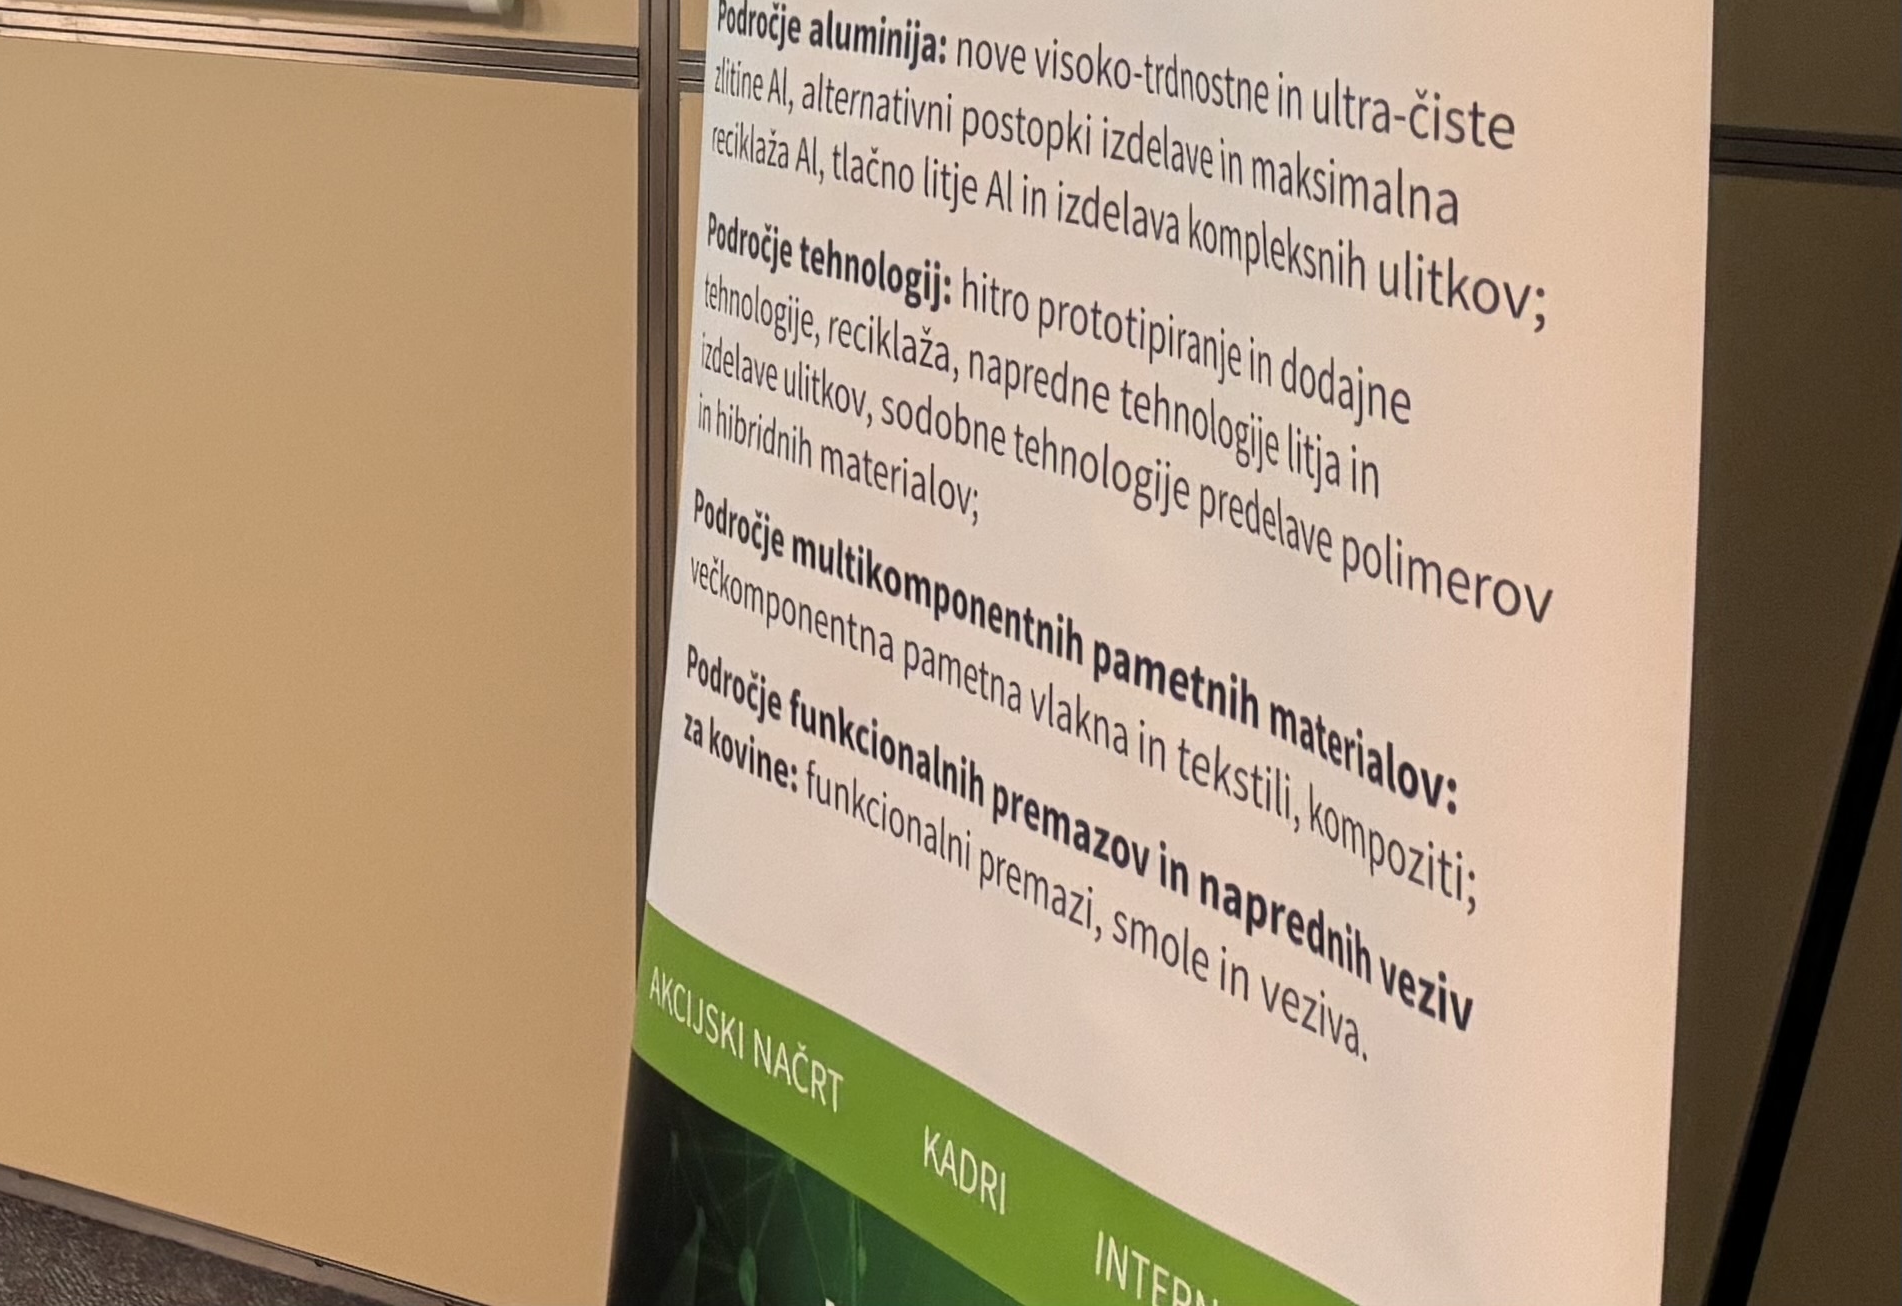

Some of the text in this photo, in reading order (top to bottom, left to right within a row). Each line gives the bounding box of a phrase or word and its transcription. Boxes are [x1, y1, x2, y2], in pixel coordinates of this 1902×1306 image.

[715, 57, 1458, 226] zlitine Al, alternativni postopki izdelave in maksimalna
[809, 10, 946, 70] aluminija:
[957, 38, 1026, 75] nove
[1035, 39, 1269, 114] visoko-trdnostne
[1279, 72, 1302, 120] in
[1314, 78, 1514, 150] ultra-čiste
[708, 212, 1411, 427] Področje tehnologij: hitro prototipiranje in dodajne
[713, 122, 1545, 332] reciklaža Al, tlačno litje Al in izdelava kompleksnih ulitkov;
[702, 337, 1553, 623] izdelave ulitkov, sodobne tehnologije predelave polimerov
[694, 488, 1456, 814] Področje multikomponentnih pametnih materialov:
[684, 713, 1367, 1061] za kovine: funkcionalni premazi, smole in veziva.
[687, 644, 1473, 1031] Področje funkcionalnih premazov in naprednih veziv
[650, 966, 843, 1112] AKCIJSKI NAČRT
[924, 1126, 1005, 1215] KADRI
